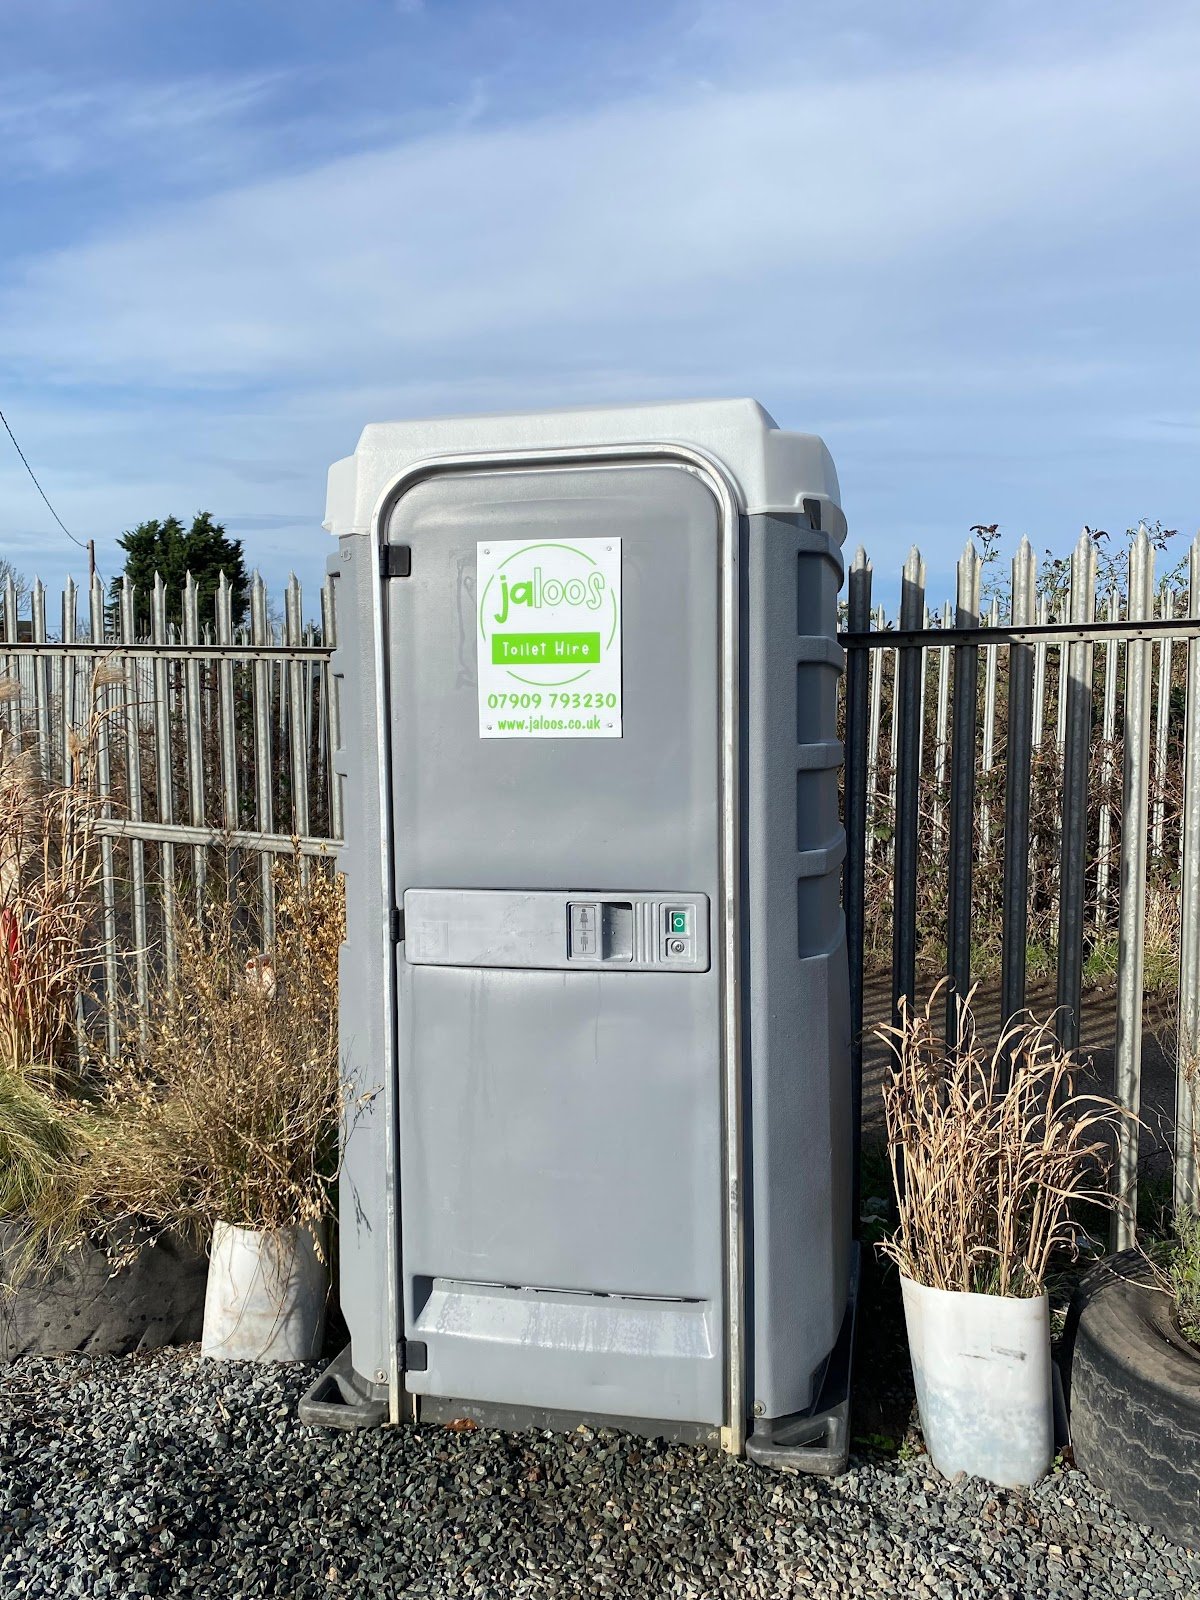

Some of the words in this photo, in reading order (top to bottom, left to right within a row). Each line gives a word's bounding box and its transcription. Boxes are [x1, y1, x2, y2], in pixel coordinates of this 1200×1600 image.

[494, 567, 605, 624] jaloos
[503, 641, 547, 656] Toilet
[555, 640, 590, 656] Hire
[487, 693, 542, 709] 07909
[549, 692, 617, 709] 793230
[497, 715, 601, 733] www.jaloos.co.uk
